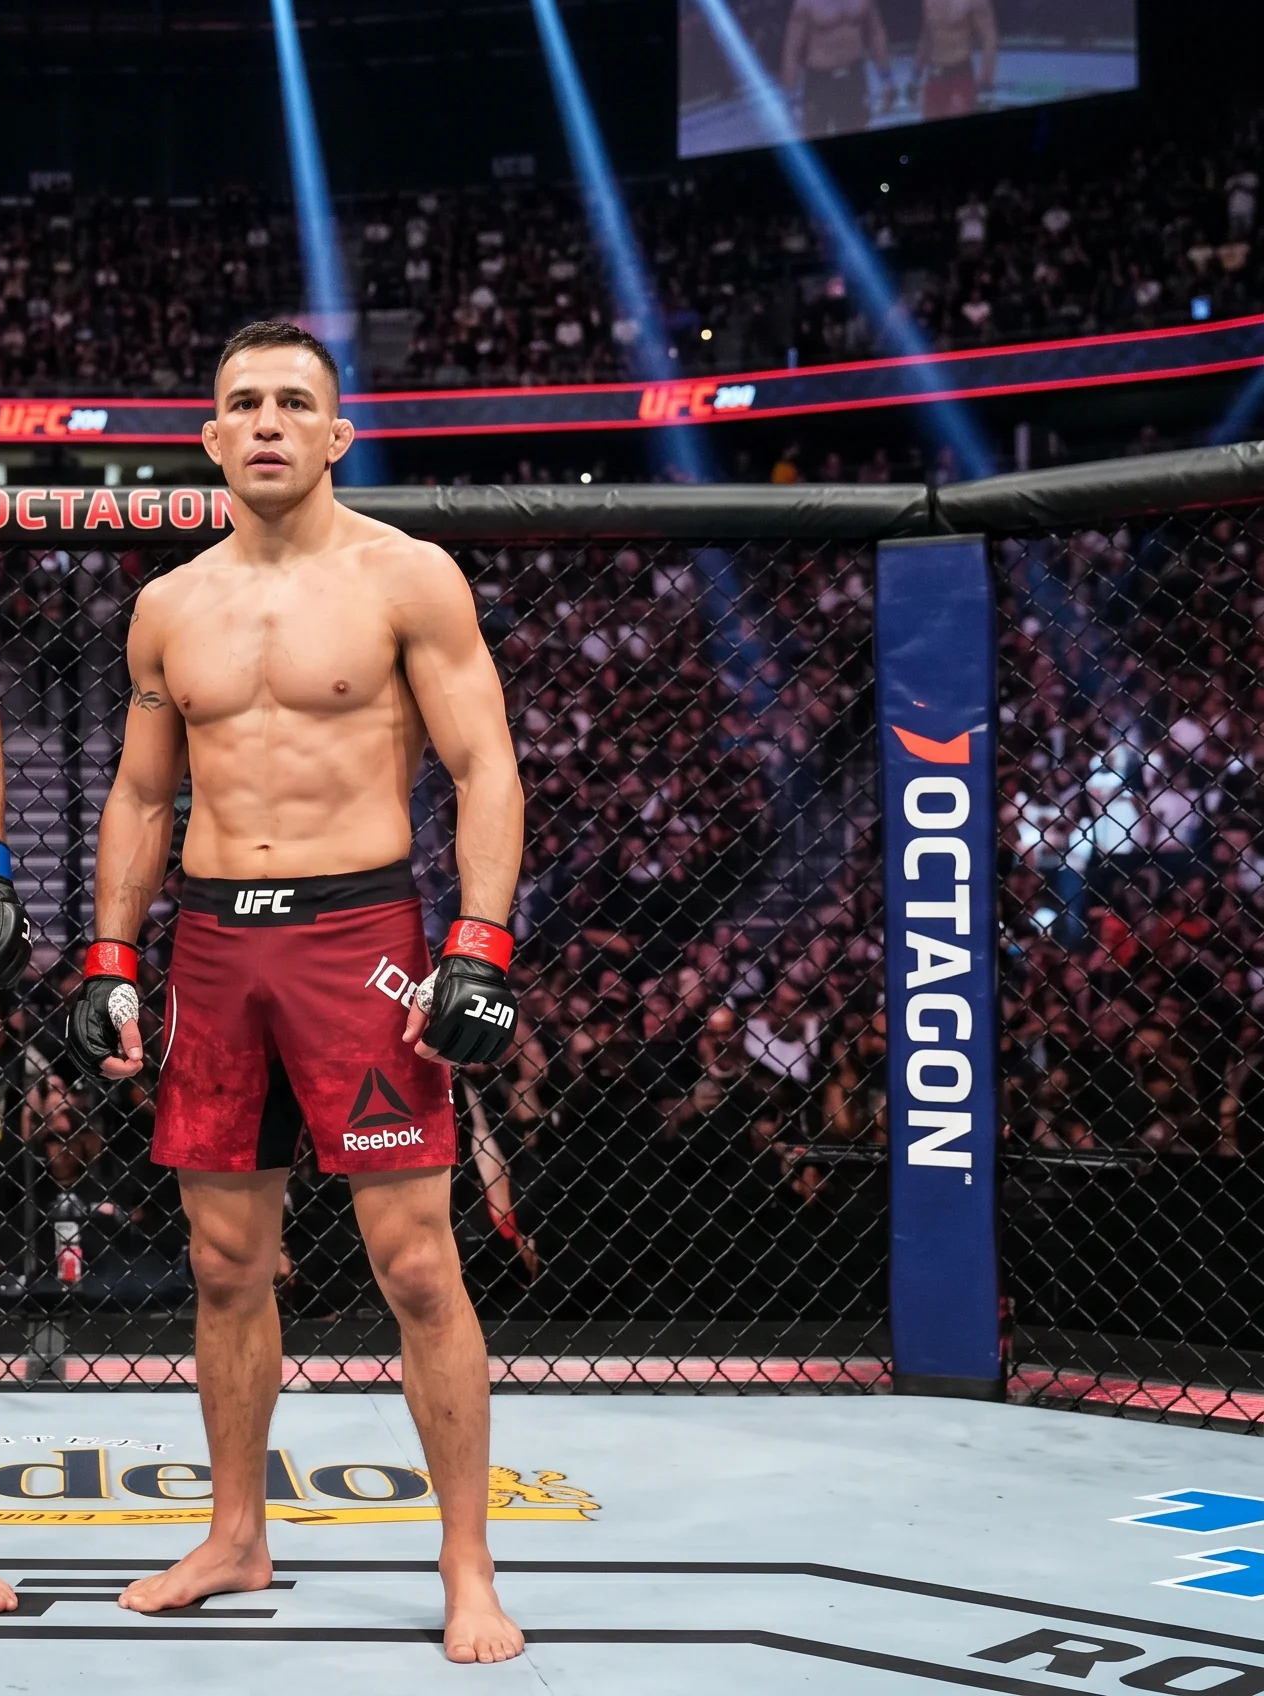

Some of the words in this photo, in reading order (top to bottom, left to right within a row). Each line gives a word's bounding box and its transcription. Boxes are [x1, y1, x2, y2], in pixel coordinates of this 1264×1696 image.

[638, 384, 717, 421] UFC
[234, 889, 295, 915] UFC
[903, 776, 973, 1169] OCTAGON
[464, 994, 515, 1029] UFC
[343, 1127, 425, 1152] Reebok
